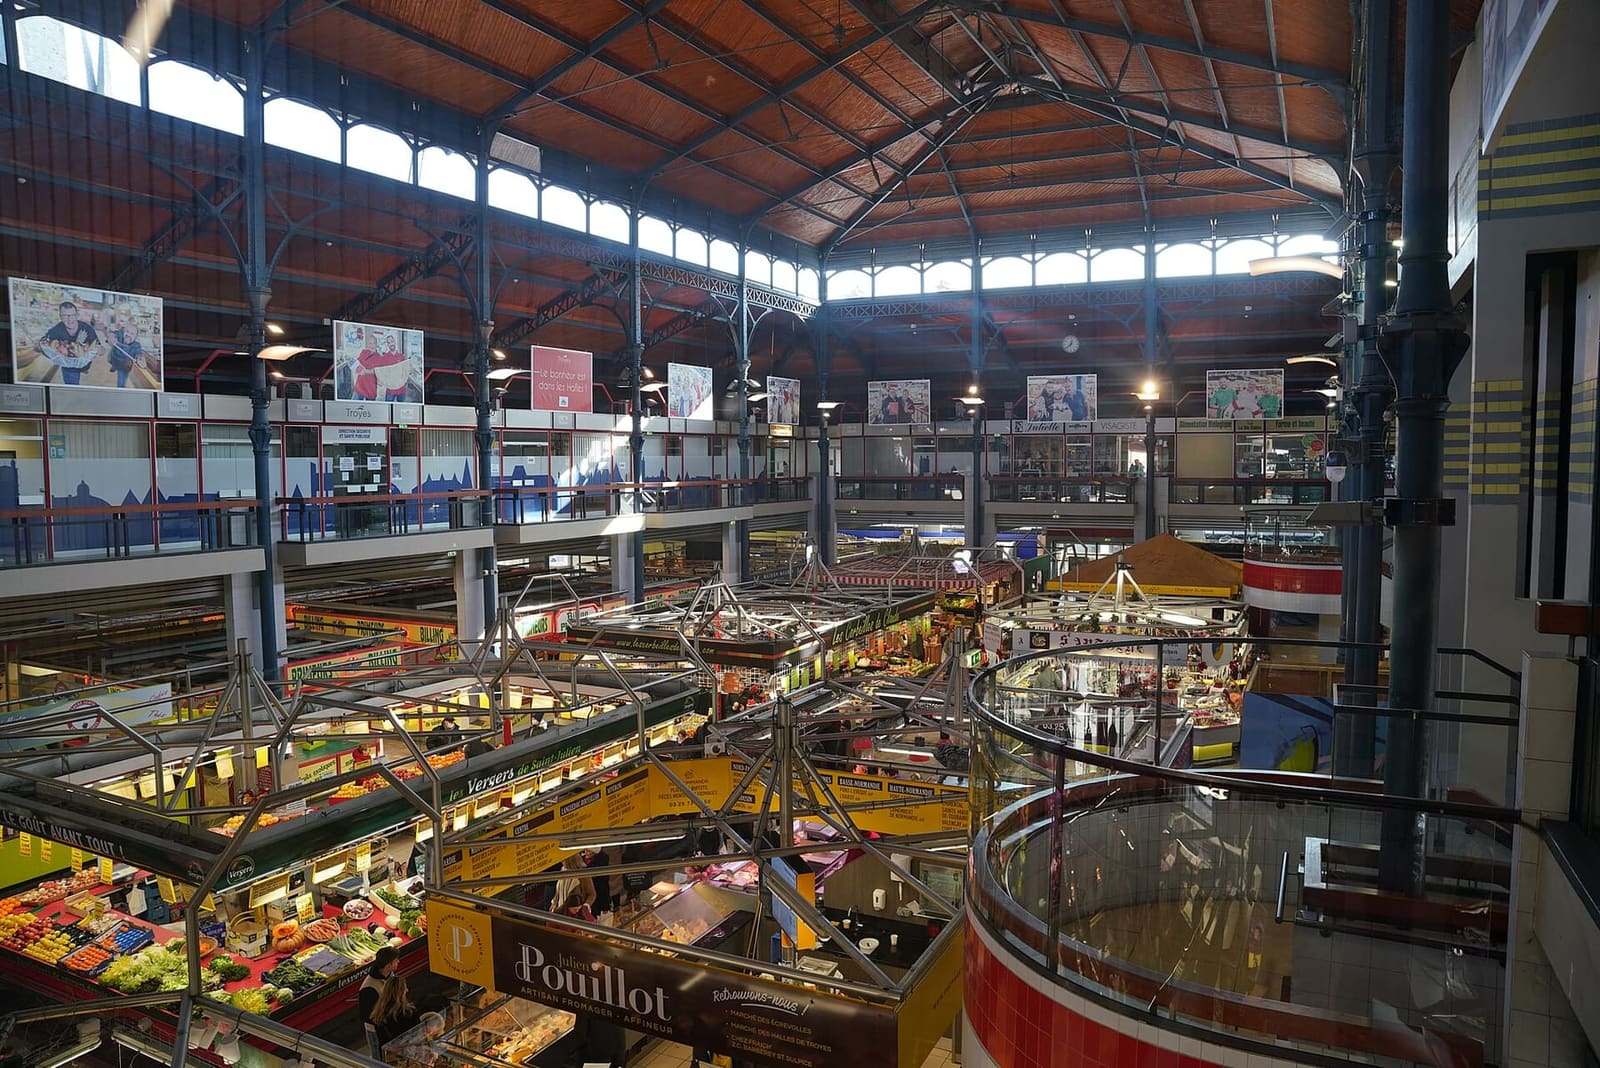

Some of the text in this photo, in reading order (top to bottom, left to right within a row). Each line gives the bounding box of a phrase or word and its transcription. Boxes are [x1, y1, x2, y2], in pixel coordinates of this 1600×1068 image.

[345, 406, 372, 419] Troyes
[420, 626, 444, 641] BILLING
[449, 744, 582, 802] les Vergers de Saint-Julien
[839, 777, 881, 791] BASSE-NORMANDIE
[2, 809, 18, 825] LE
[19, 814, 48, 836] GOÛT
[50, 824, 82, 843] AVANT
[86, 835, 115, 857] TOUT
[229, 866, 253, 879] Vergers
[446, 923, 474, 963] P
[557, 952, 590, 972] Julien
[514, 942, 673, 1022] Pouillot
[520, 985, 560, 1004] ARTISAN
[561, 997, 613, 1018] FROMAGER
[623, 1014, 674, 1035] AFFINEUR
